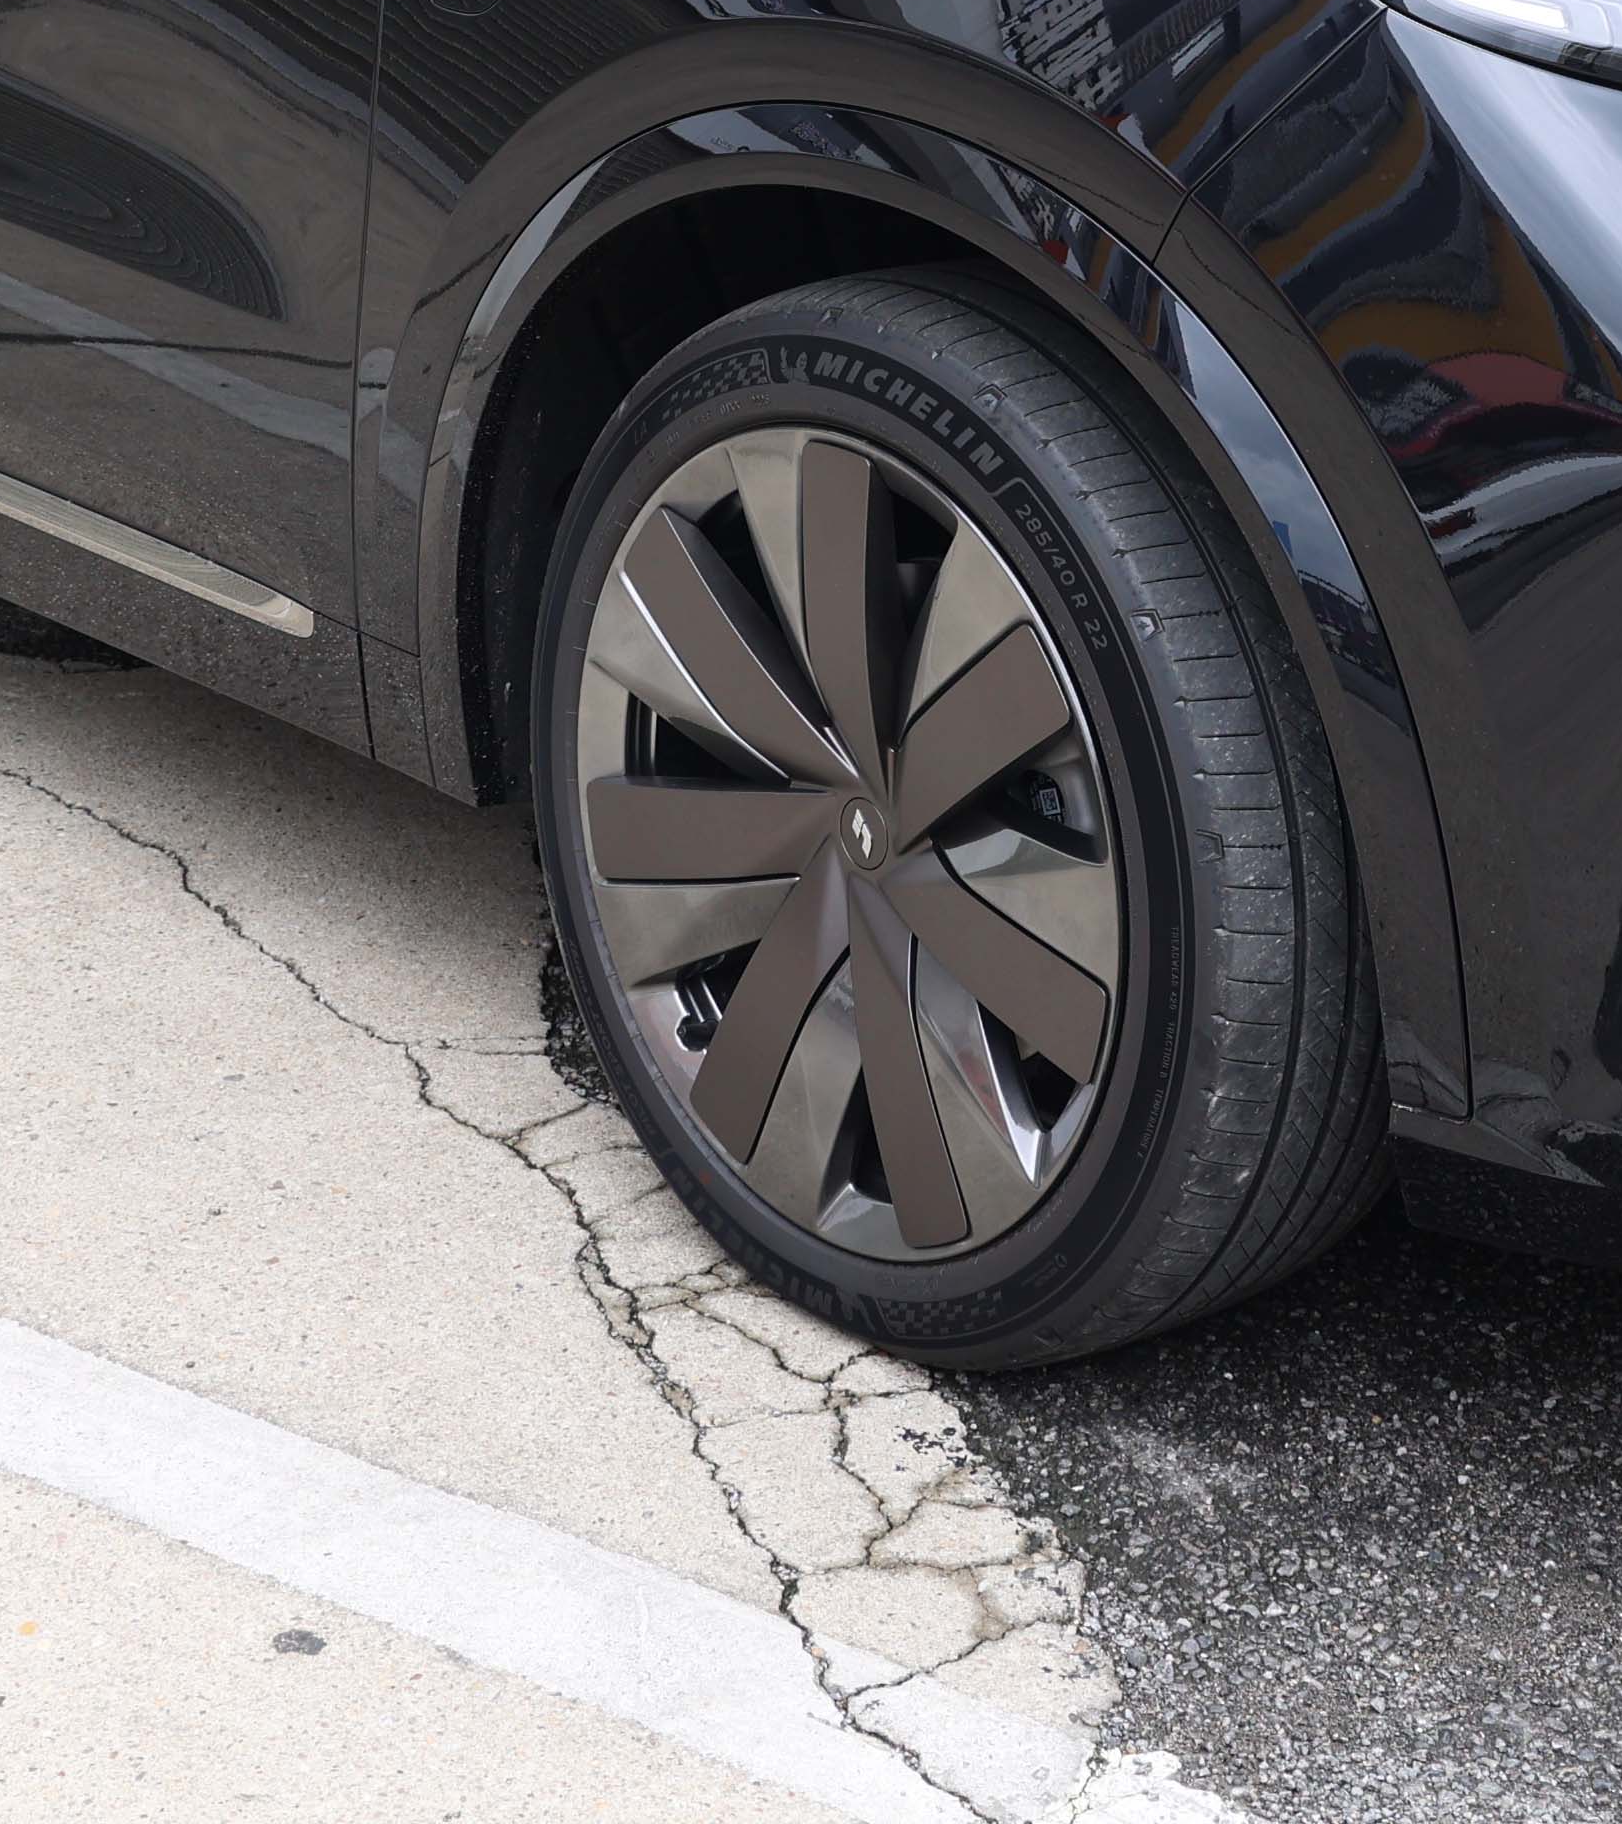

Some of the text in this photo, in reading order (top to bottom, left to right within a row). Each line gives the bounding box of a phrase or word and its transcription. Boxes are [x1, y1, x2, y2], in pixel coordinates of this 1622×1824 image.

[813, 351, 1109, 651] MICHELIN 285/40 R 22
